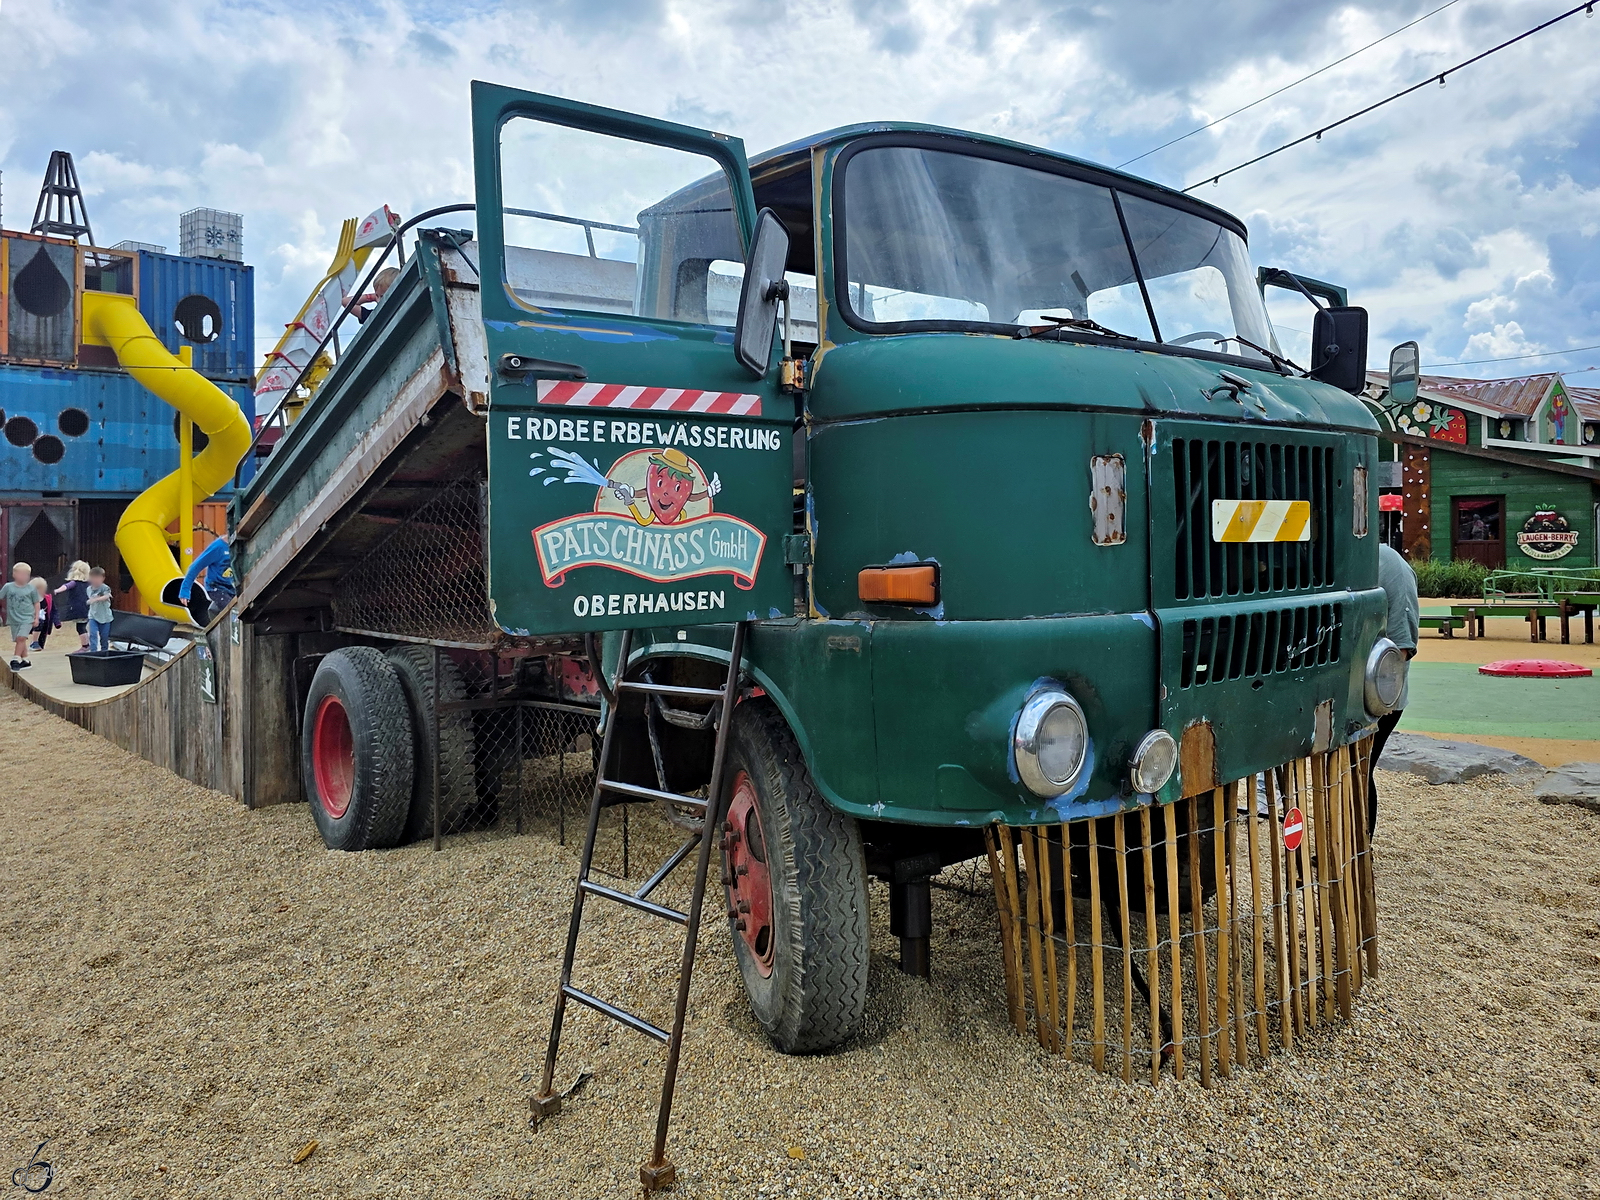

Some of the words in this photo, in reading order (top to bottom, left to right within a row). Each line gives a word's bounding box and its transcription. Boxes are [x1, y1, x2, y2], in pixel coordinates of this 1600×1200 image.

[508, 417, 781, 451] ERDBEERBEWÄSSERUNG
[543, 522, 705, 570] PATSCHNASS
[709, 528, 748, 561] GmbH
[574, 591, 725, 617] OBERHAUSEN
